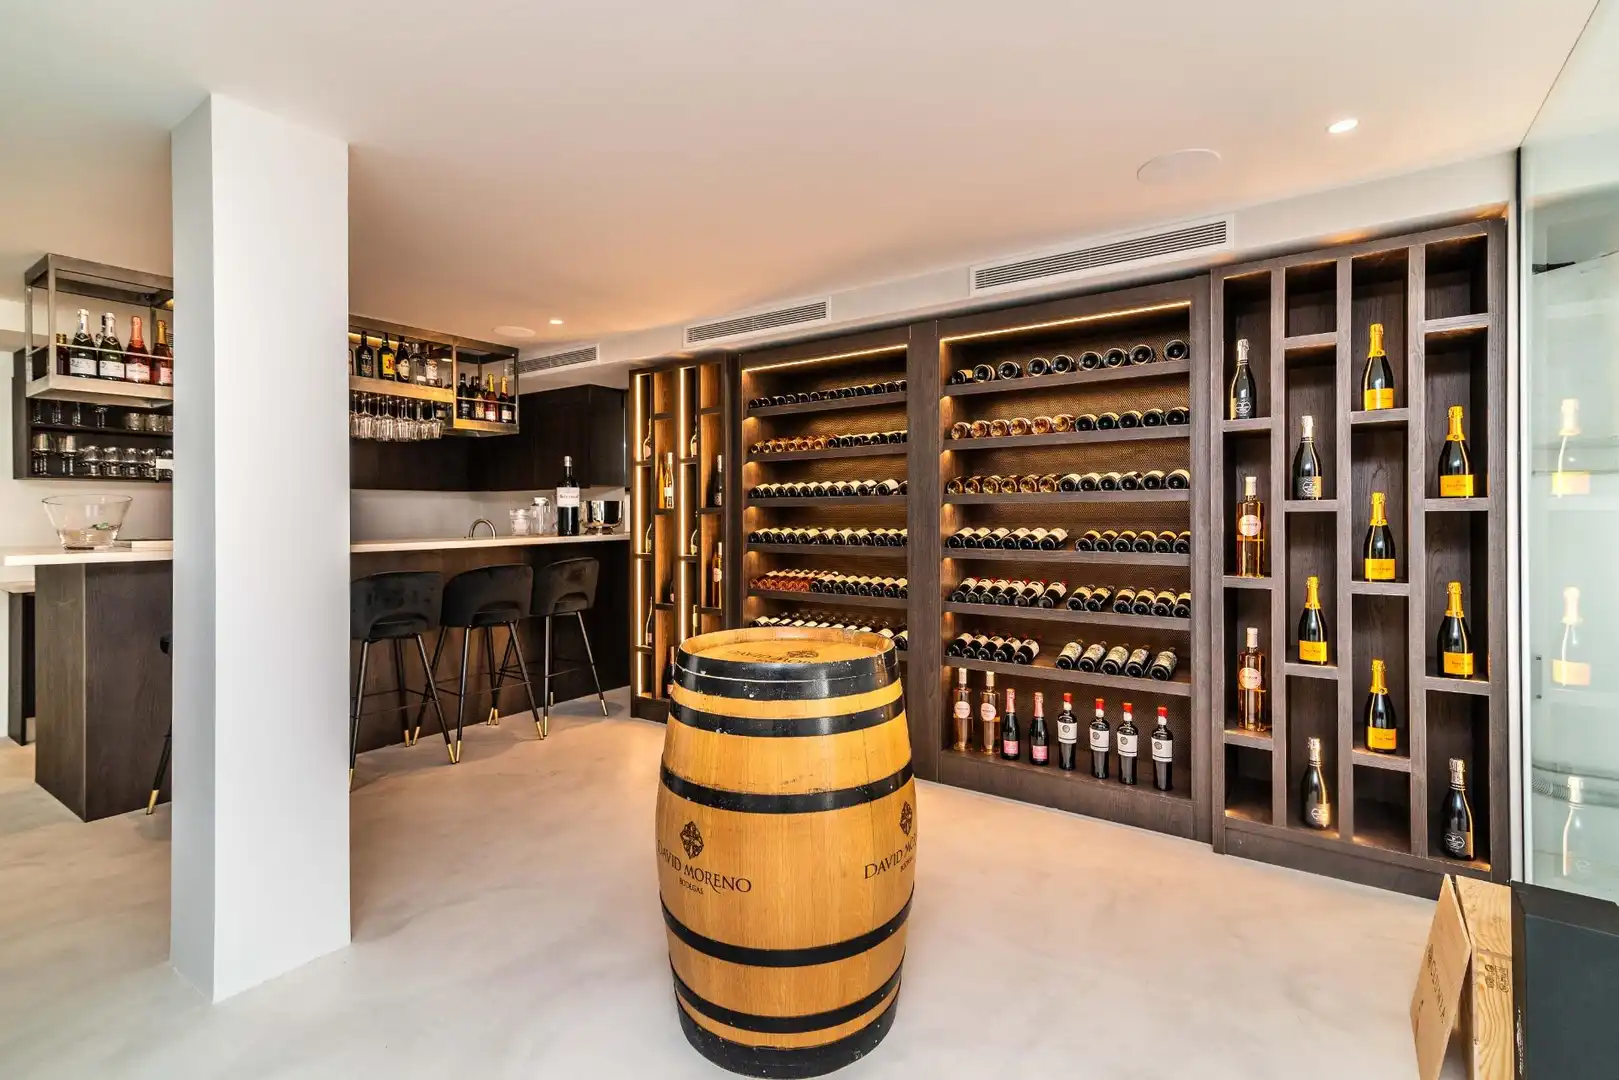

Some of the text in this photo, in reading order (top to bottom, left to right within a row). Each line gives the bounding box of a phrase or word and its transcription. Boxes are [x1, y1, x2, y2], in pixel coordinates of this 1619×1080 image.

[657, 839, 752, 895] DAVID MORENO
[864, 849, 903, 879] DAVID
